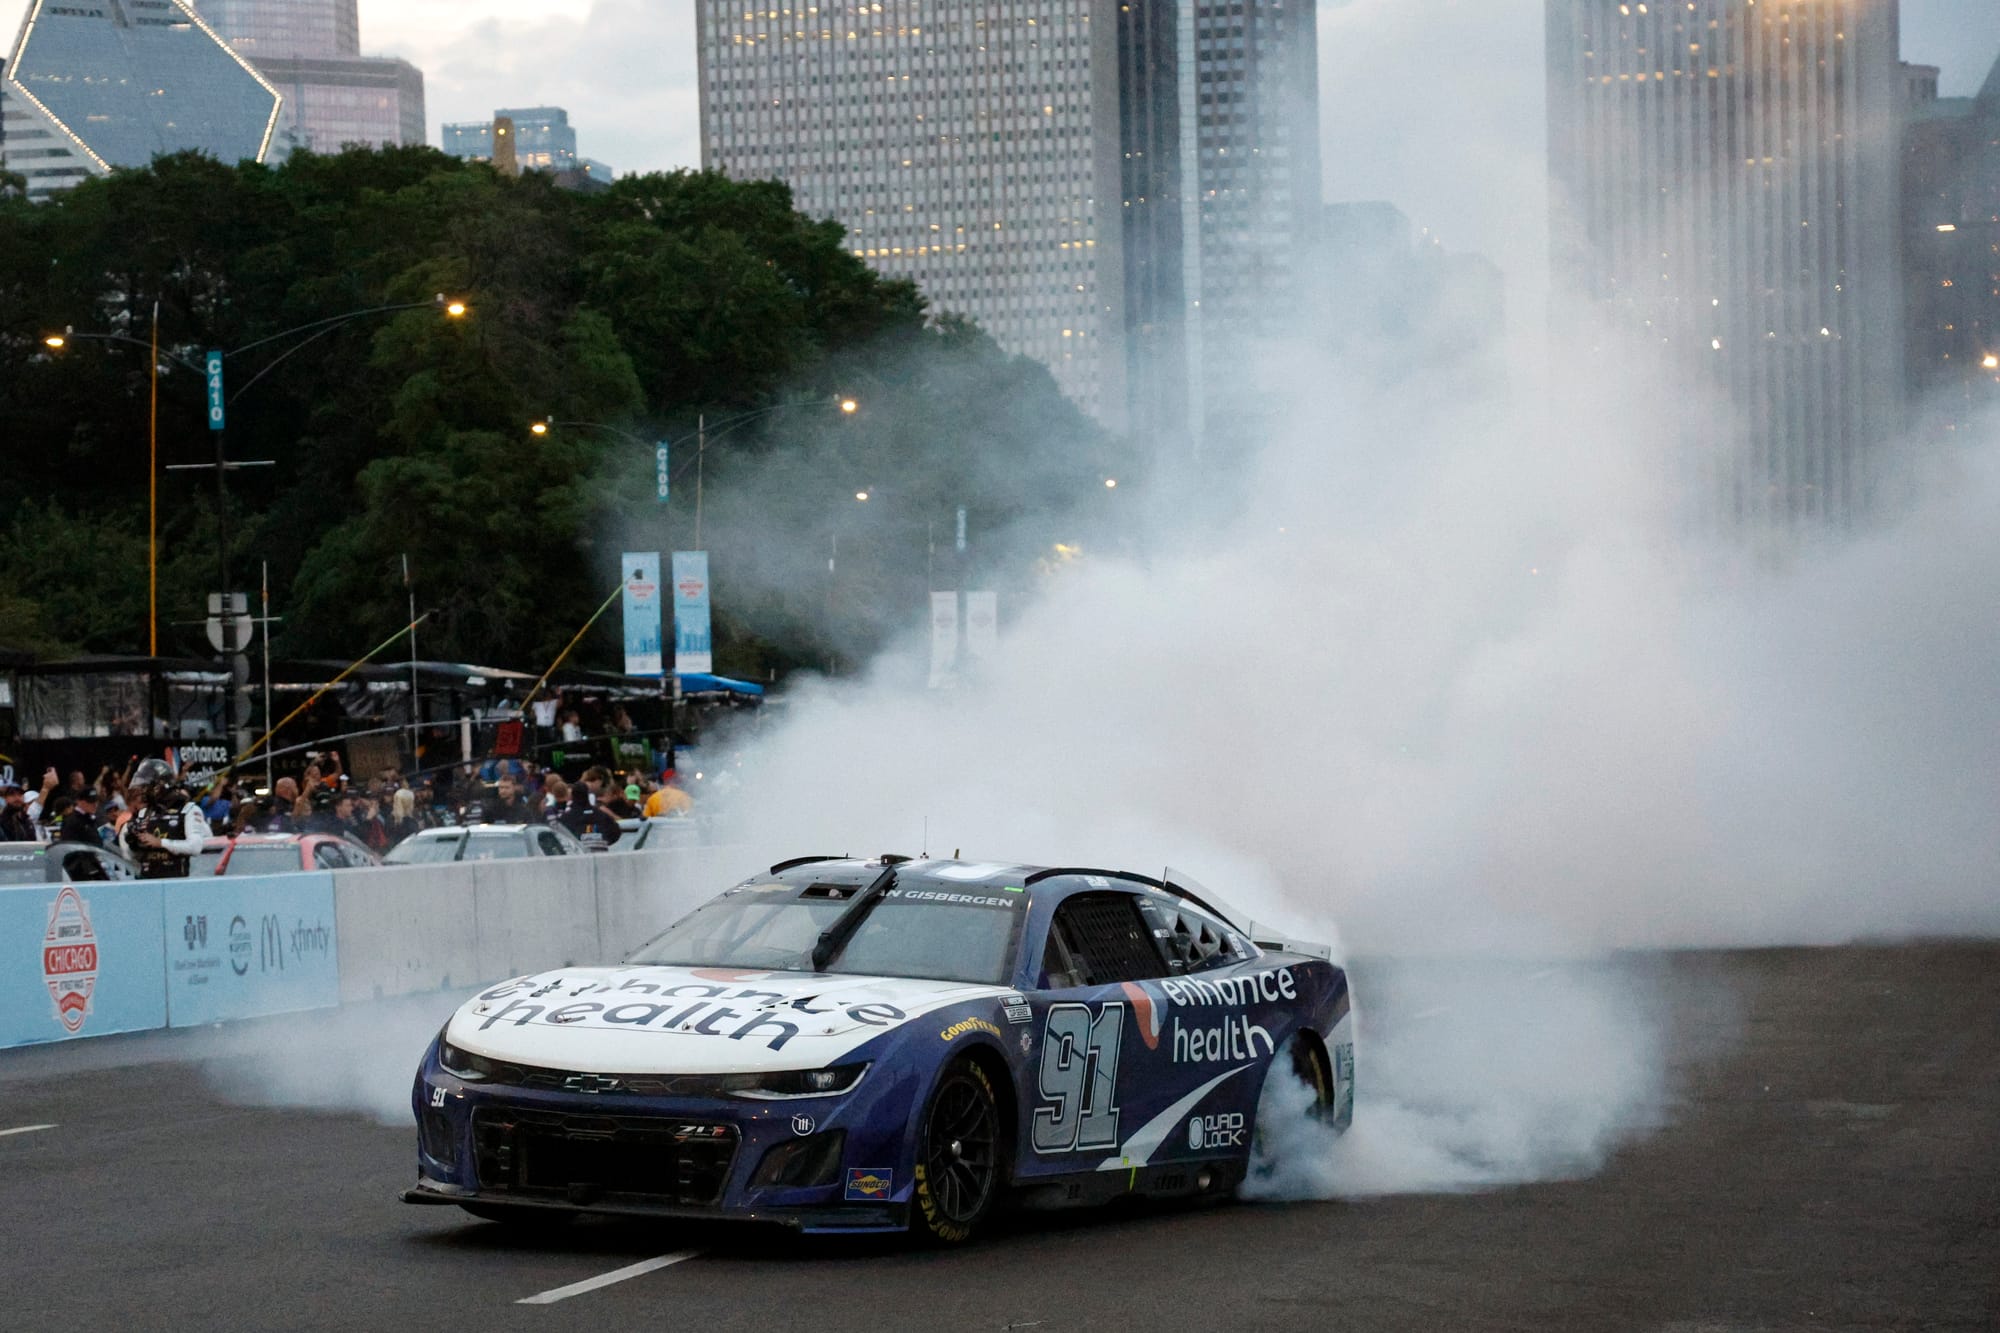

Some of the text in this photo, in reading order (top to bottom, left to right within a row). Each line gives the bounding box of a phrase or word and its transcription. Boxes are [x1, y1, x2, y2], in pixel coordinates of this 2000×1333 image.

[208, 359, 223, 421] C410
[180, 741, 227, 762] enhance
[904, 890, 1014, 907] GISBERGEN
[290, 918, 331, 962] xfinity
[48, 946, 93, 972] CHICAGO
[1161, 968, 1297, 1006] enhance
[479, 1000, 799, 1052] health
[1173, 1014, 1274, 1063] health
[1031, 1001, 1125, 1154] 91
[431, 1087, 448, 1107] 91
[1204, 1113, 1244, 1131] QUAD
[1204, 1129, 1243, 1148] LOCK
[849, 1179, 890, 1190] SUNOCO
